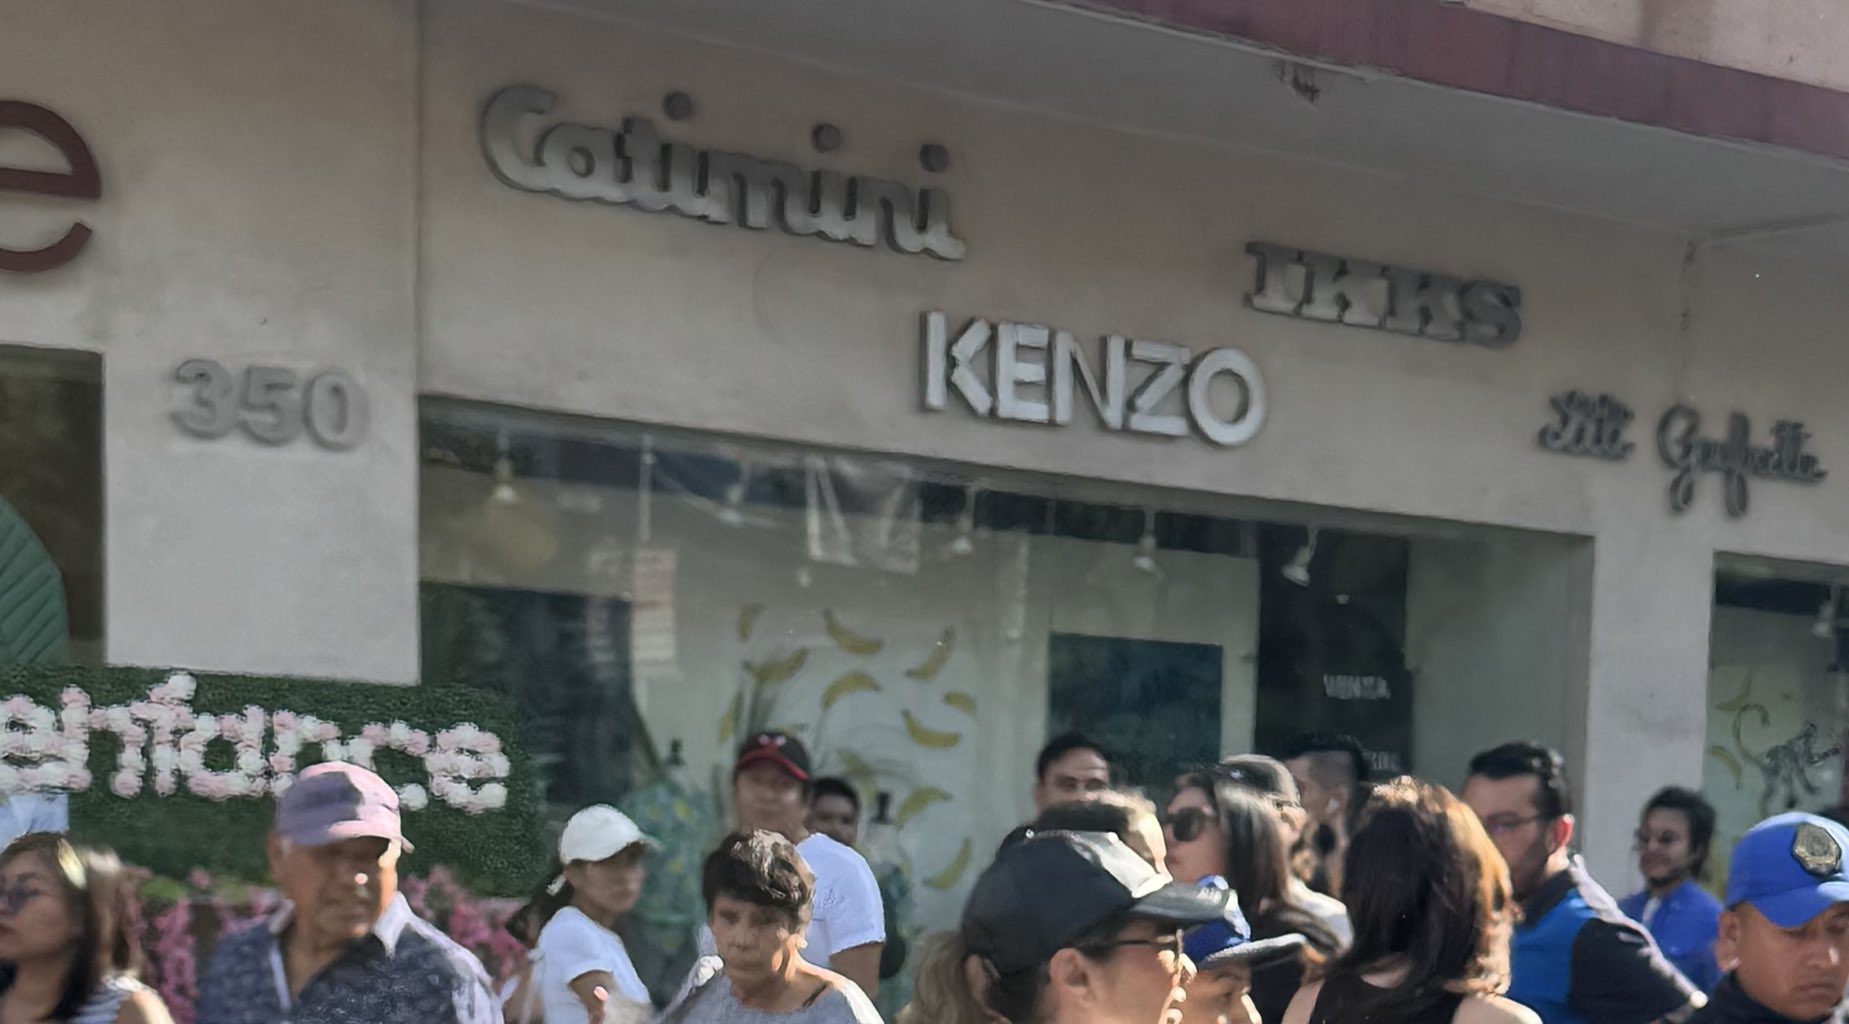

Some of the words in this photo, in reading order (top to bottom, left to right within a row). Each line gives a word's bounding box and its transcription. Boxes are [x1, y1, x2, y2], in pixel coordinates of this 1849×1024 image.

[482, 84, 966, 262] Catimini
[1245, 240, 1522, 349] IKKS
[171, 358, 371, 453] 350
[919, 308, 1268, 447] KENZO
